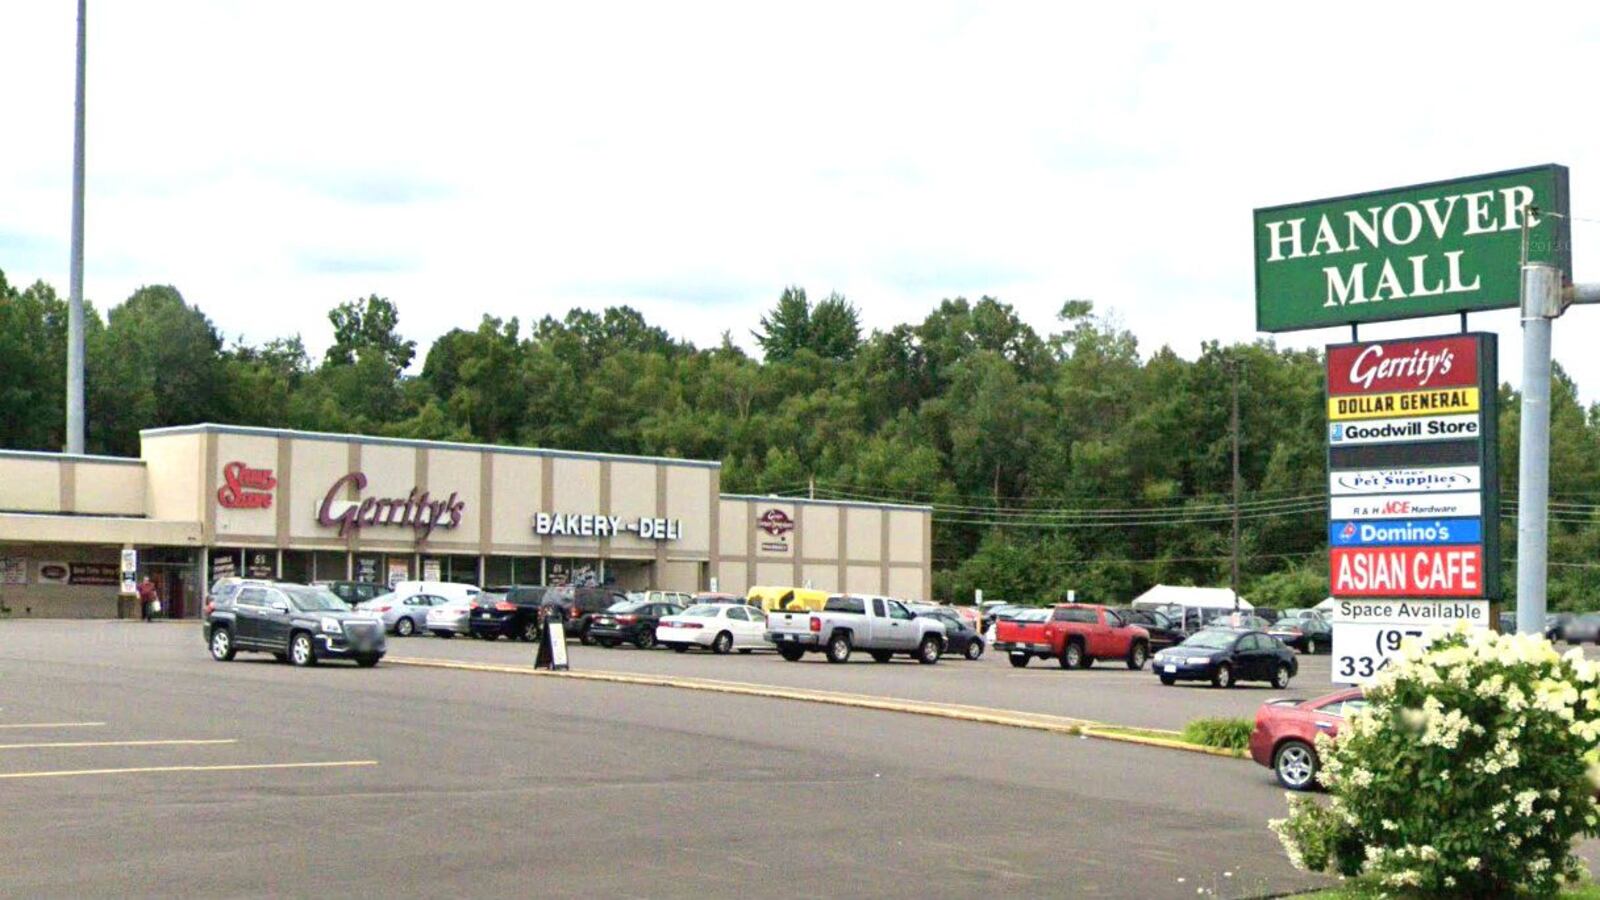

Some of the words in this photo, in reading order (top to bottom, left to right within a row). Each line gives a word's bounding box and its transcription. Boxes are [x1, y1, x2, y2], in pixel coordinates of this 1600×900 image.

[1265, 185, 1541, 262] HANOVER
[1322, 249, 1481, 308] MALL
[1349, 344, 1455, 390] Gerrity's
[1338, 396, 1394, 415] DOLLAR
[1399, 391, 1470, 411] GENERAL
[1345, 421, 1422, 439] Goodwill
[1427, 420, 1478, 436] Store
[1354, 475, 1379, 486] Pet
[1384, 473, 1456, 487] Supplies
[317, 471, 465, 543] Gerrity's
[1382, 500, 1412, 515] ACE
[1411, 504, 1457, 514] Hardware
[536, 512, 621, 537] BAKERY
[1360, 521, 1450, 542] Domino's
[1337, 552, 1407, 591] ASIAN
[1412, 551, 1477, 590] CAFE
[1340, 601, 1393, 620] Space
[1398, 602, 1482, 620] Available
